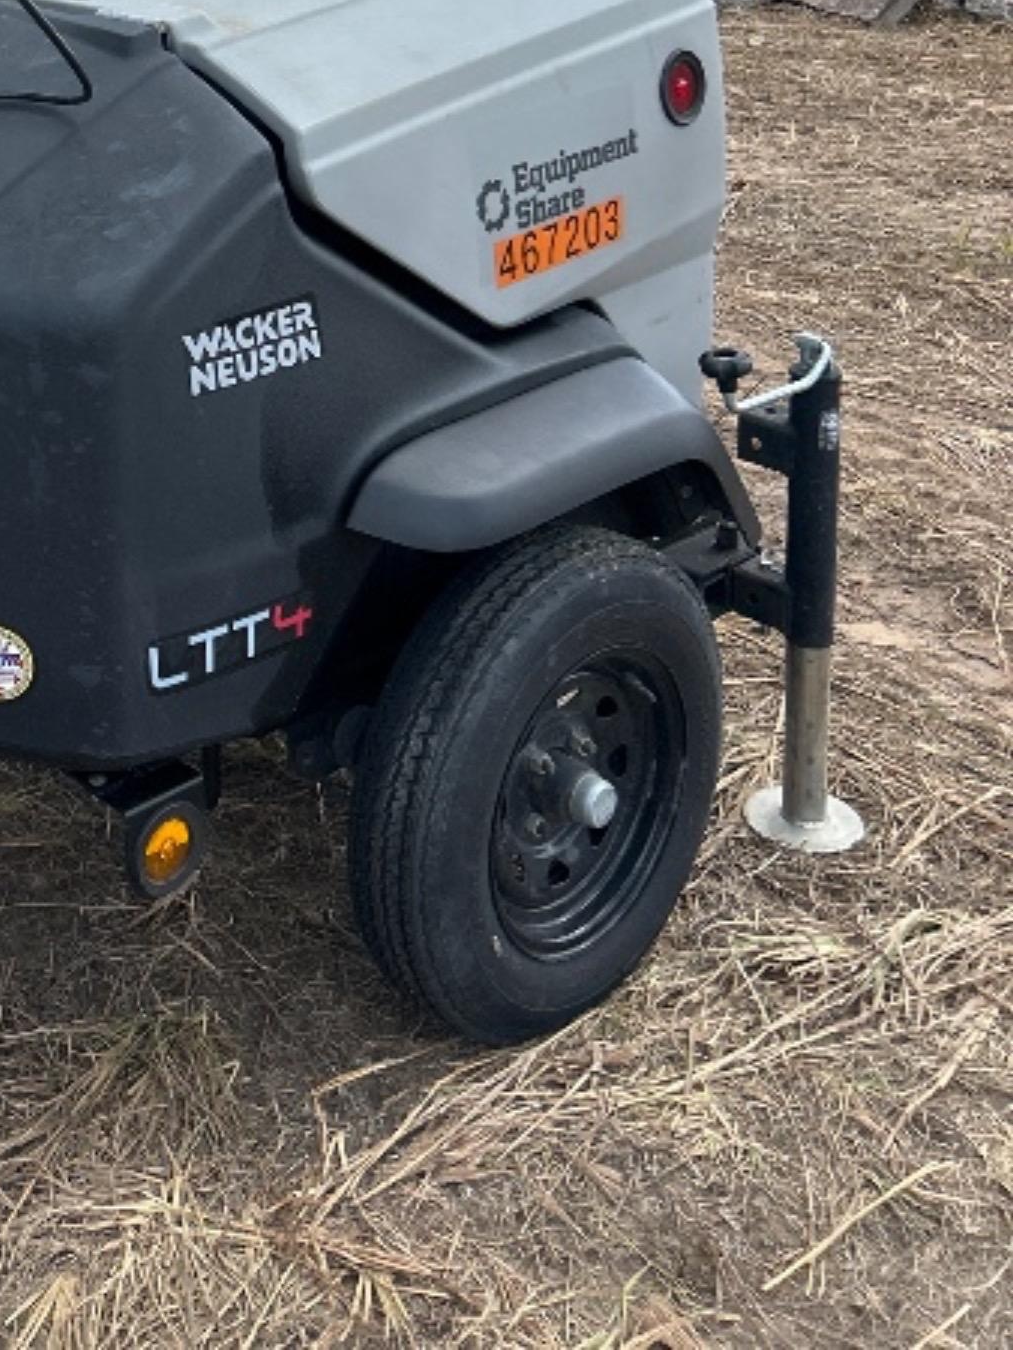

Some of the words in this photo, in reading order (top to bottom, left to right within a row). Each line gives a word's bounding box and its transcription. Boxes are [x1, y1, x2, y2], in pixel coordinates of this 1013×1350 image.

[512, 129, 638, 193] Equipment
[498, 200, 619, 279] 467203
[515, 186, 585, 229] Share
[182, 301, 316, 362] WACKER
[189, 330, 321, 397] NEUSON
[147, 604, 313, 690] LTT4
